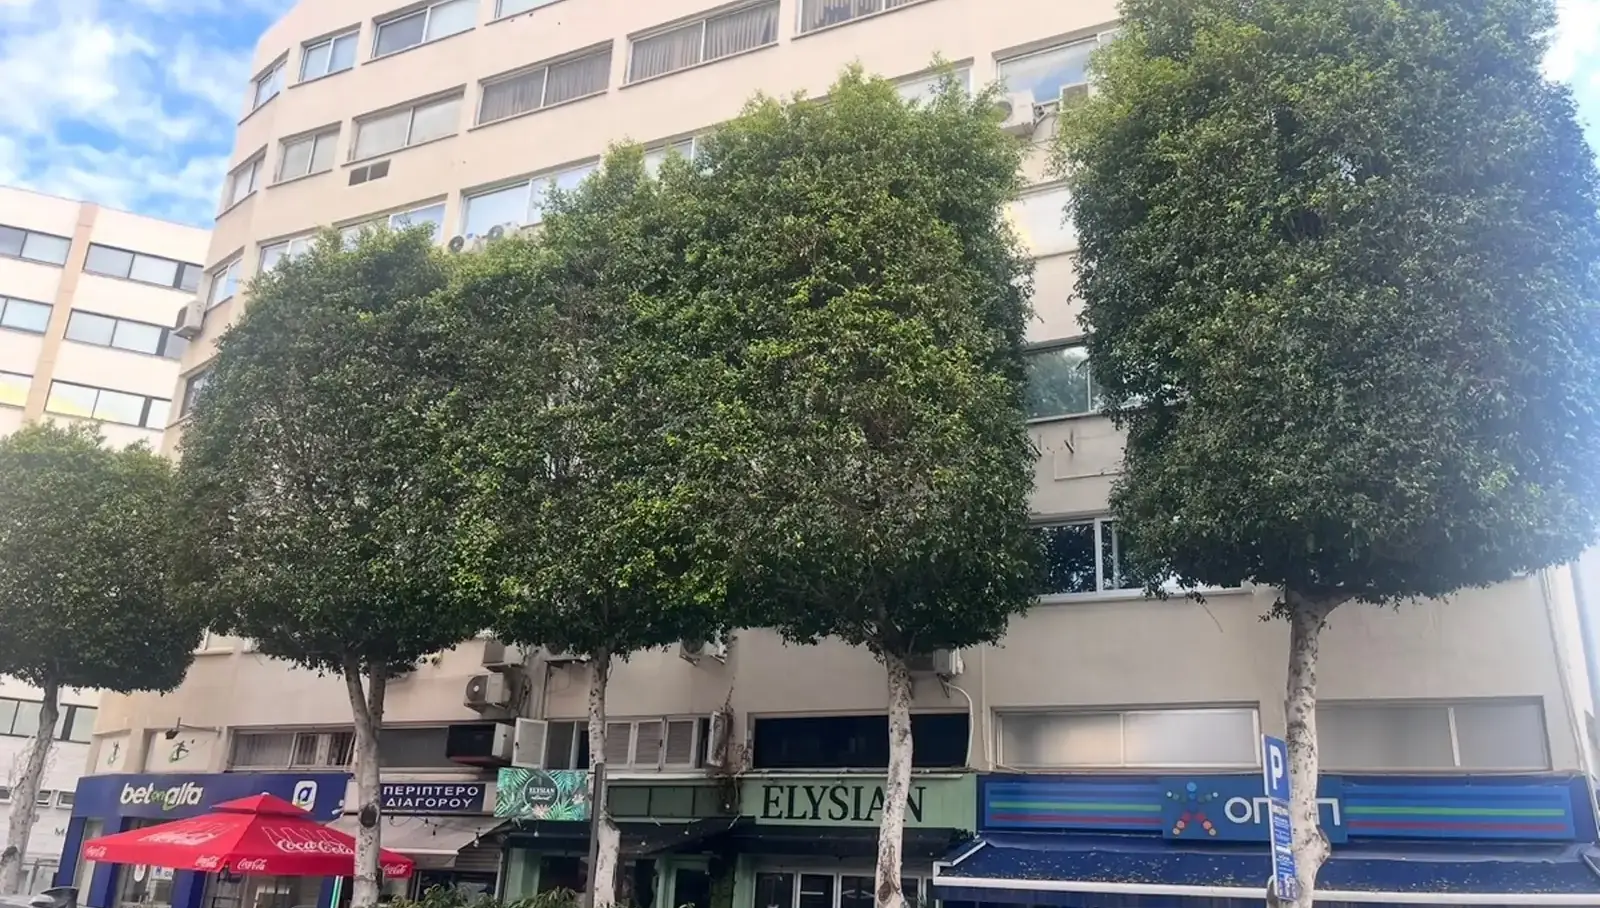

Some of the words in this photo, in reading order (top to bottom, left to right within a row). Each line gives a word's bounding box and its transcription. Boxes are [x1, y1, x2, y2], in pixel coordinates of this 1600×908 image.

[1269, 744, 1283, 790] P
[383, 785, 479, 796] ΠΕΡΙΠΤΕΡΟ
[386, 797, 473, 808] ΔΙΑΓΟΡΟΥ
